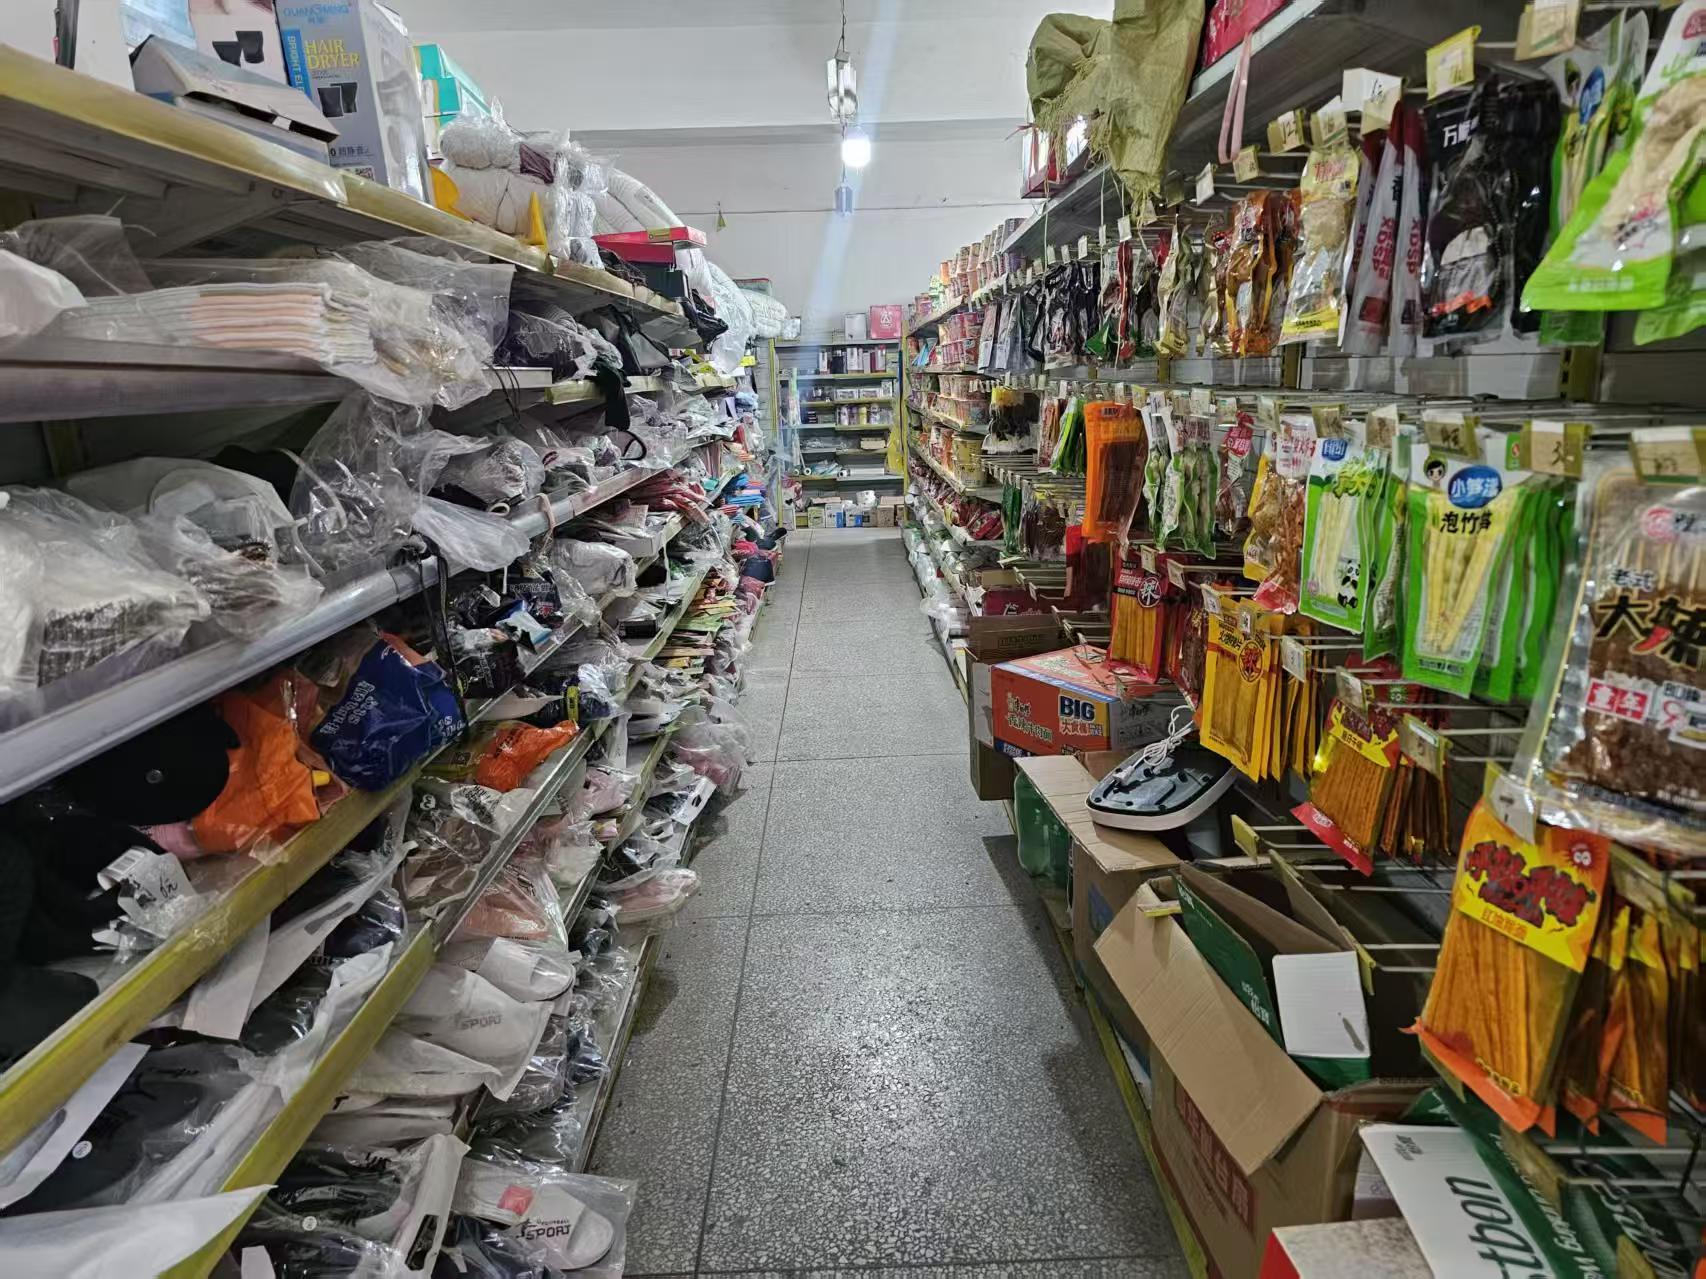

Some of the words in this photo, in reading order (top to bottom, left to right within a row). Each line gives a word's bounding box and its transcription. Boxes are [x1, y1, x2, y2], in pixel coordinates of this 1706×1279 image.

[304, 38, 344, 55] HAIR
[307, 53, 359, 70] DRYER
[1059, 694, 1095, 721] BIG
[526, 1225, 571, 1241] SPORT
